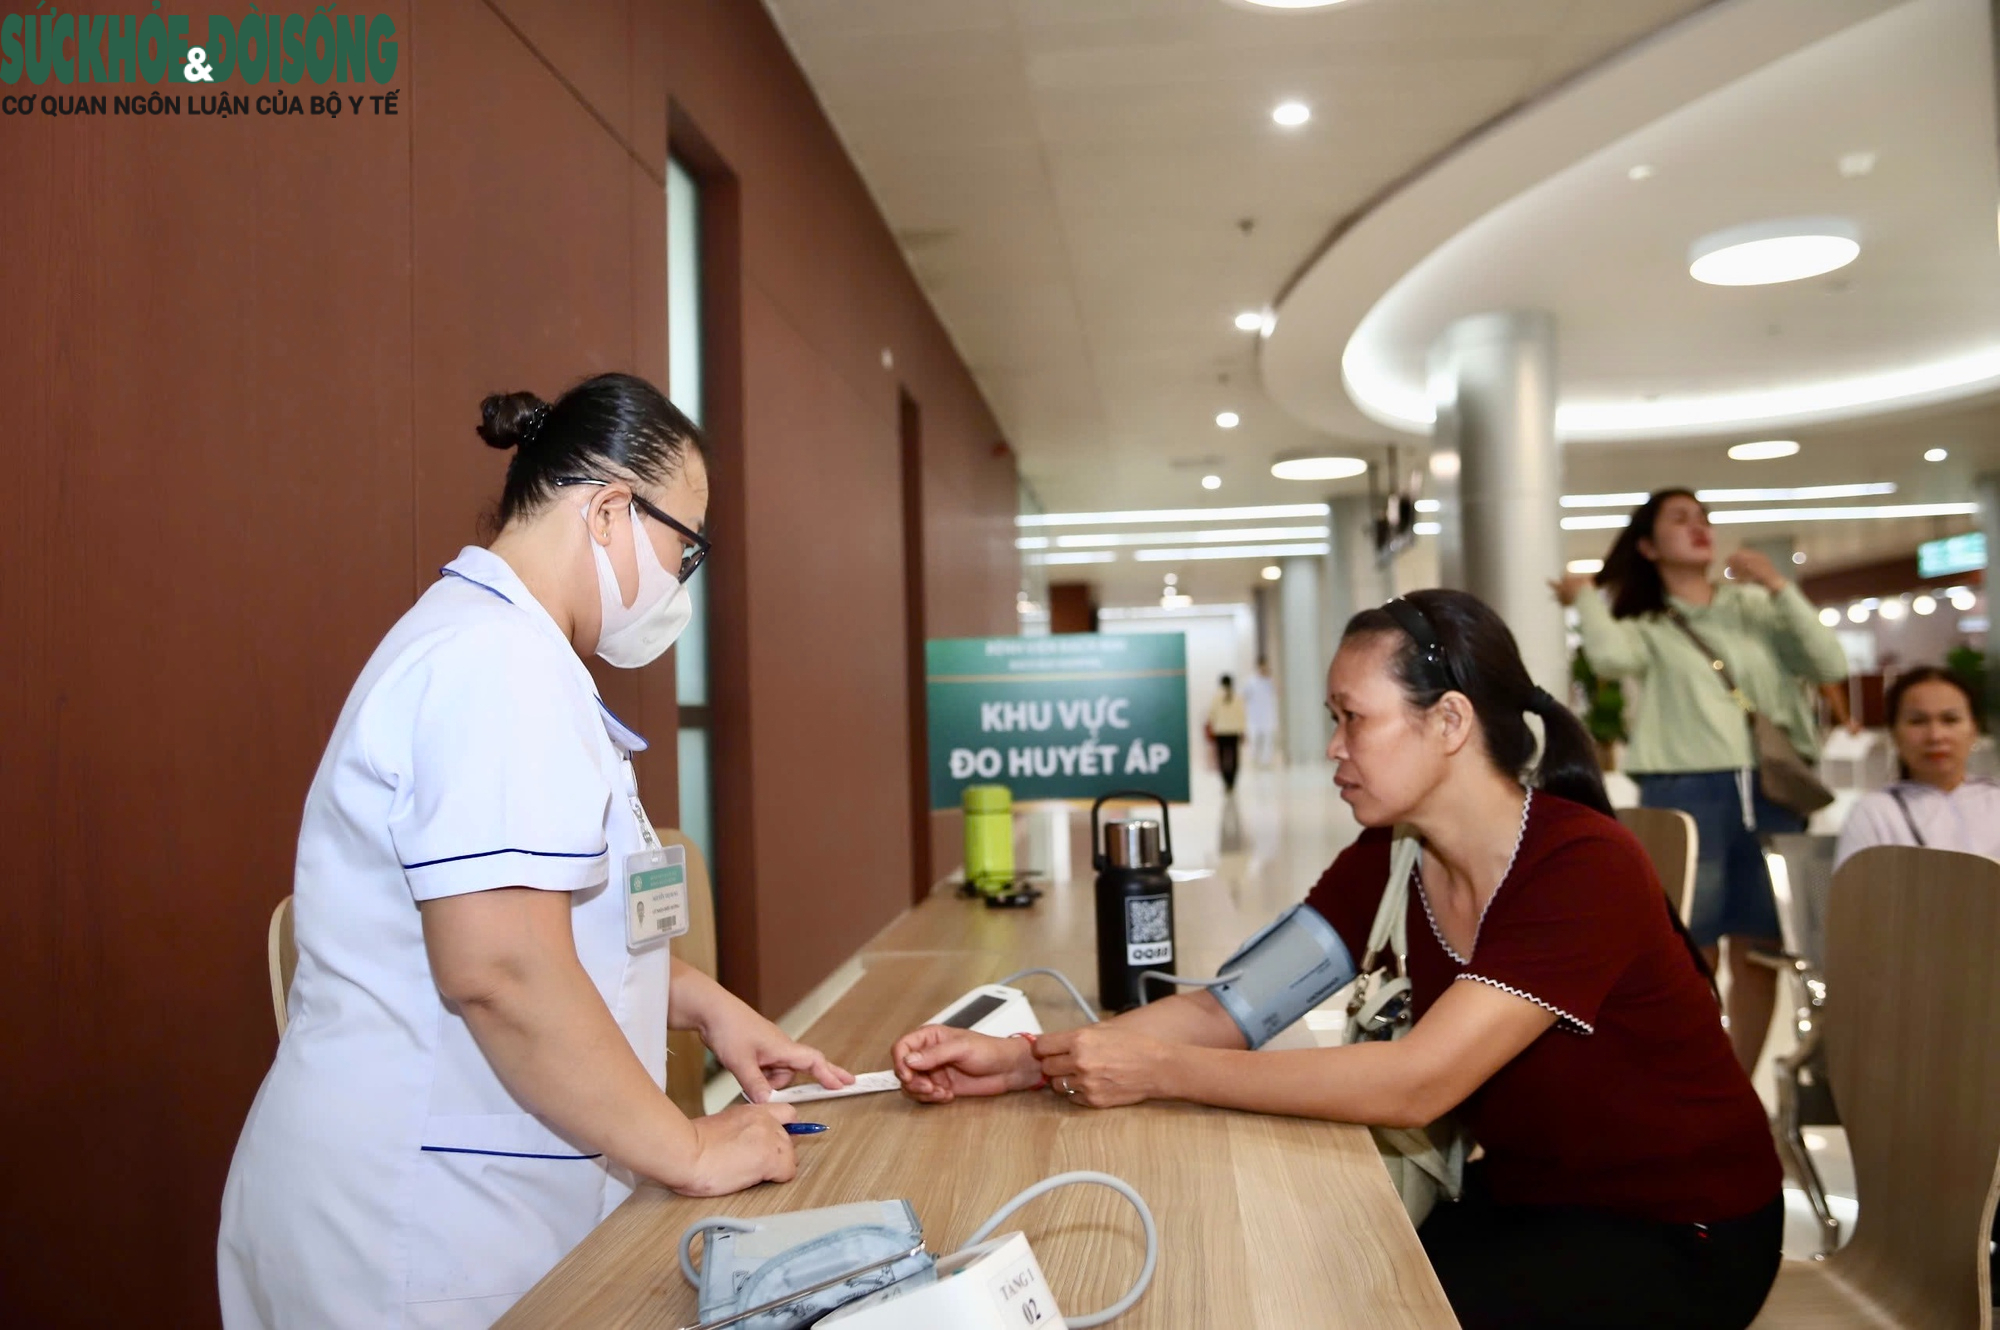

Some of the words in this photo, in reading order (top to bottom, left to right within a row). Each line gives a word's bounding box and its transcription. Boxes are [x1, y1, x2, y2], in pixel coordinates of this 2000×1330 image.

[981, 701, 1052, 732] KHU
[1057, 696, 1130, 740] VỰC
[949, 748, 1002, 779] ĐO
[1008, 739, 1117, 777] HUYẾT
[1124, 738, 1171, 774] ÁP
[1022, 1298, 1041, 1325] 02
